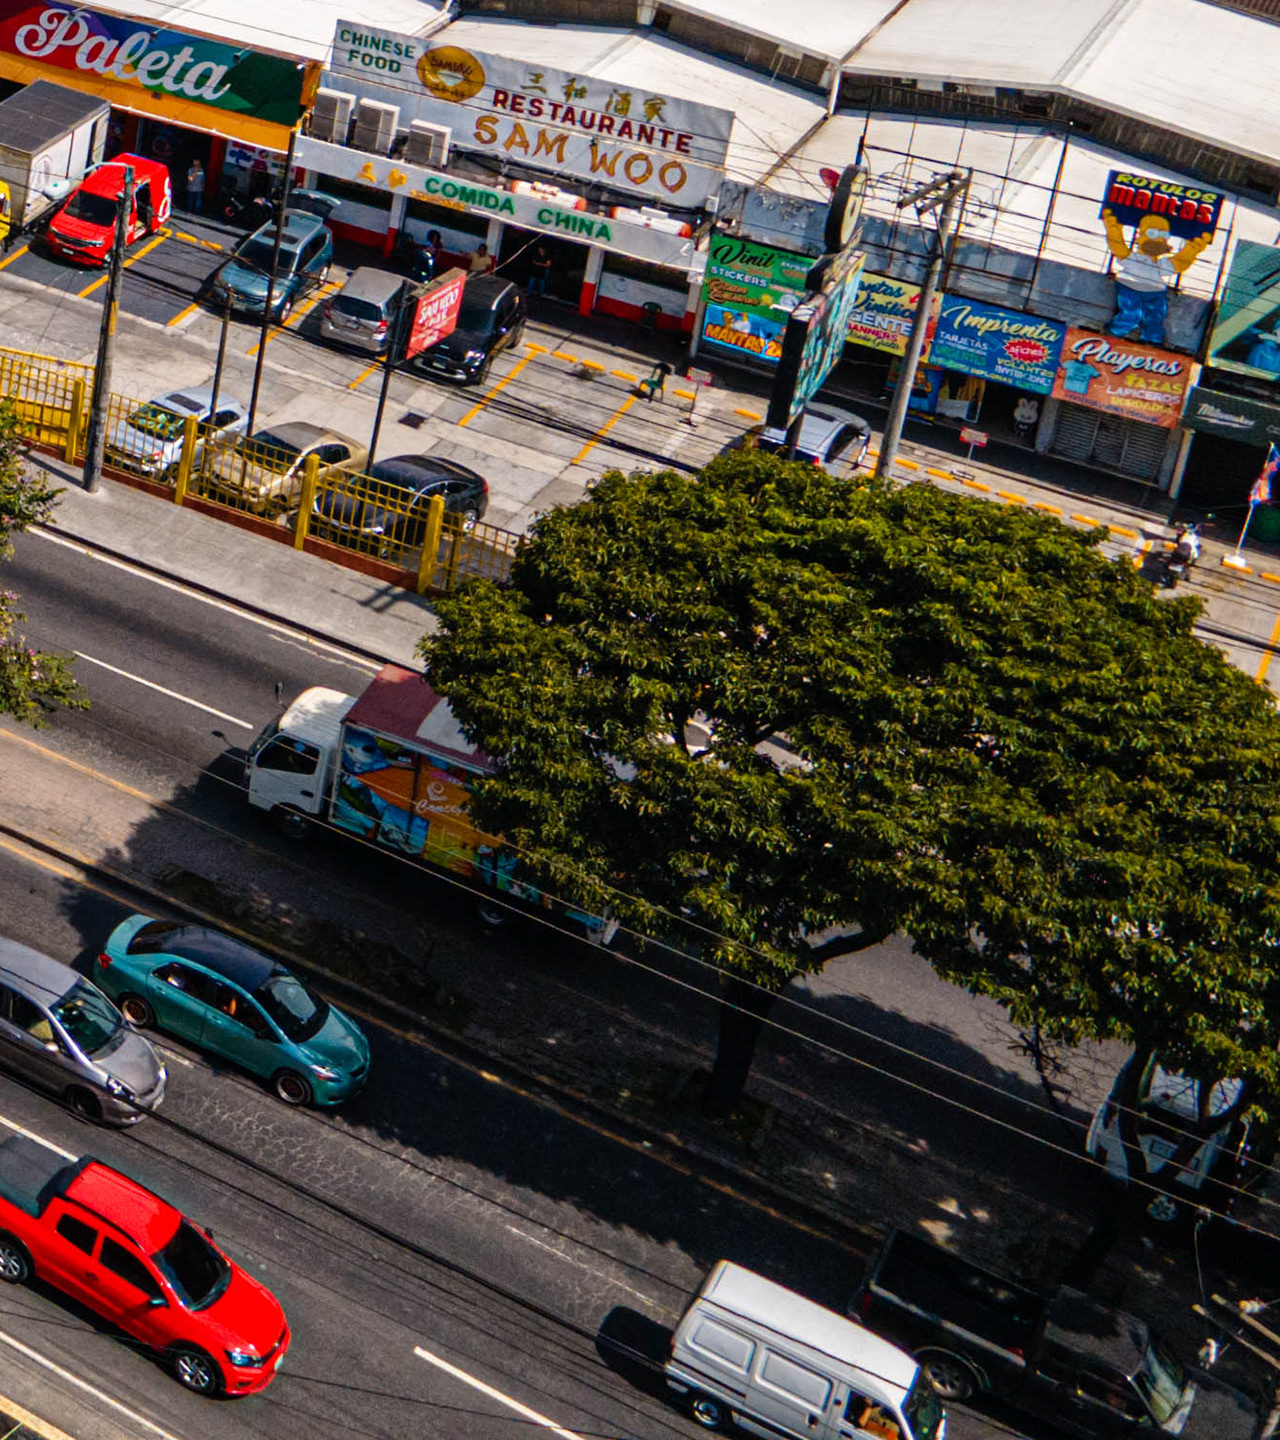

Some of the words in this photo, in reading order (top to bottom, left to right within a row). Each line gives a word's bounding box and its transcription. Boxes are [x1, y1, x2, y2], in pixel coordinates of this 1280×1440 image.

[15, 8, 232, 101] Paleta
[340, 29, 416, 59] CHINESE
[347, 48, 402, 74] FOOD
[492, 88, 695, 155] RESTAURANTE
[473, 115, 571, 164] SAM
[589, 135, 688, 194] WOO
[424, 176, 515, 216] COMIDA
[537, 207, 613, 242] CHINA
[1108, 183, 1215, 225] mantas
[712, 241, 776, 269] Vinil
[710, 266, 768, 289] STICKERS
[857, 279, 905, 299] antas
[848, 309, 912, 337] GENTE
[941, 304, 1062, 343] Imprenta
[705, 323, 766, 354] MANTAS
[939, 331, 989, 350] TARJETAS
[1071, 336, 1185, 376] Playeras
[1106, 385, 1182, 405] LAPICEROS
